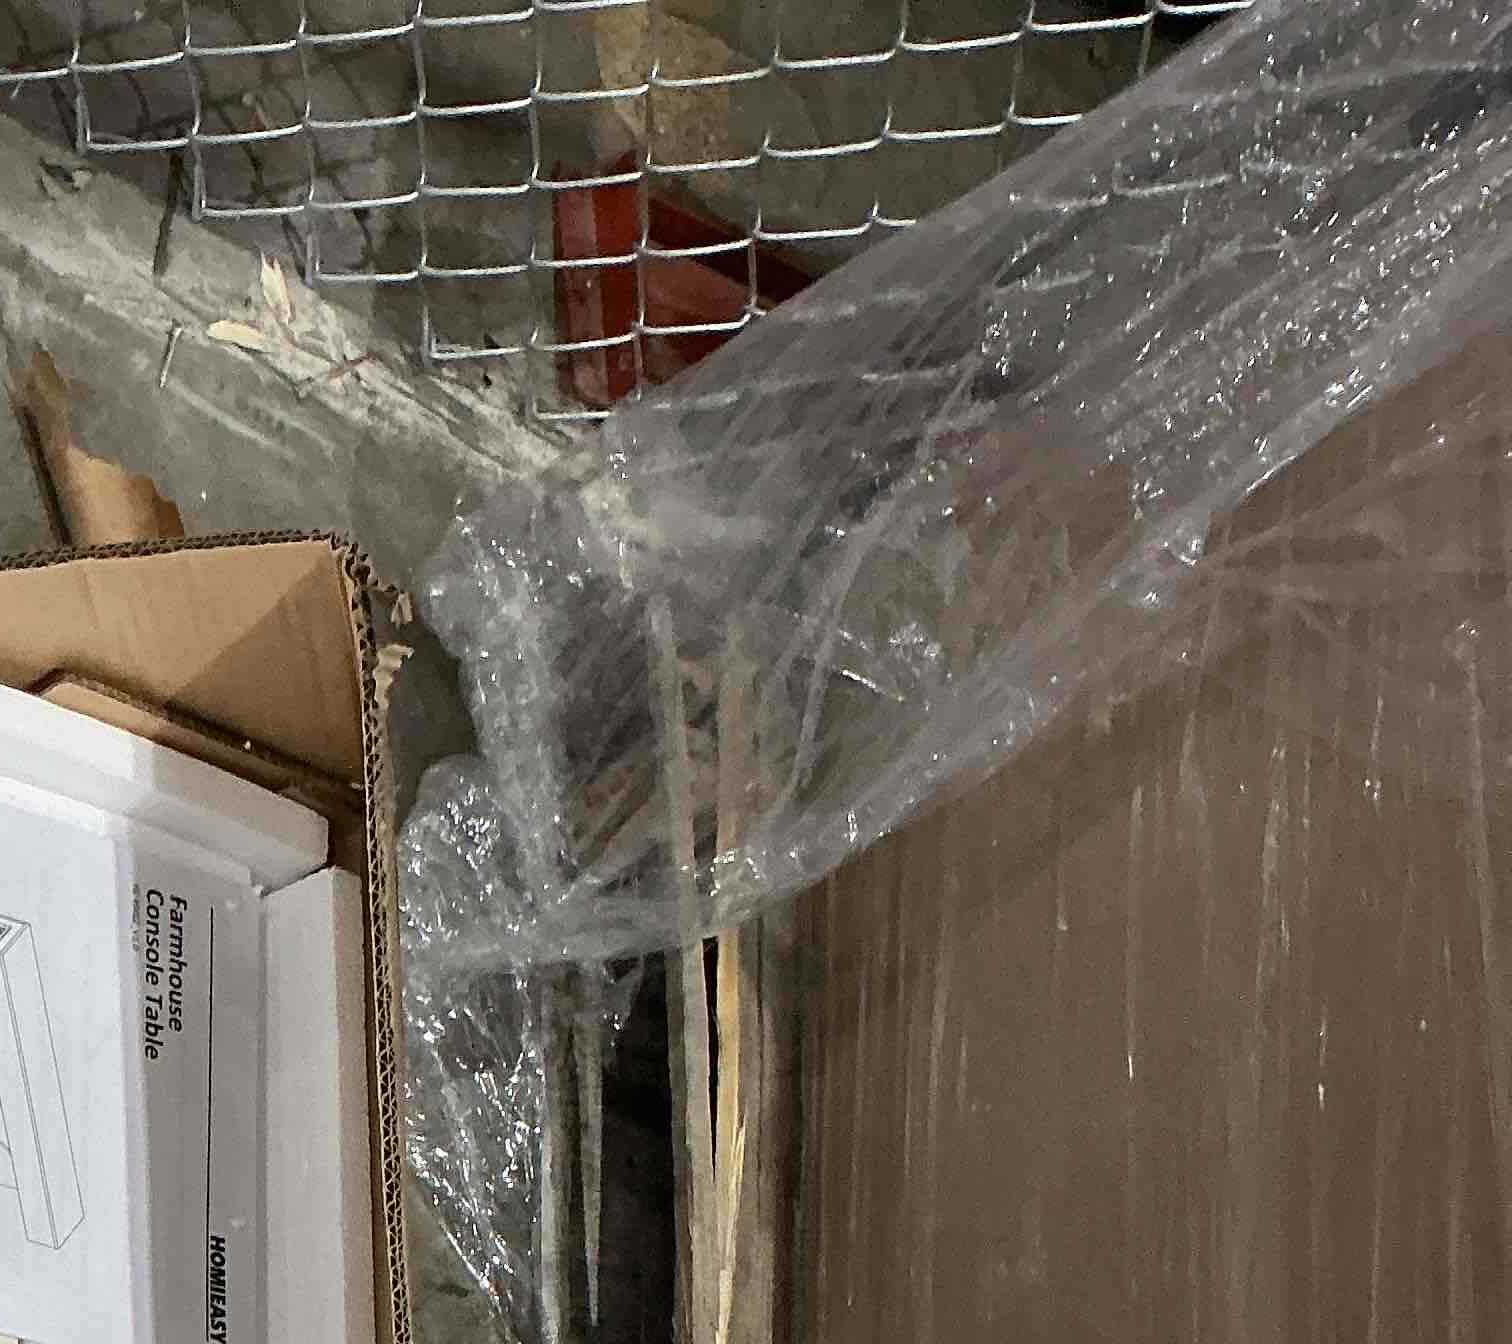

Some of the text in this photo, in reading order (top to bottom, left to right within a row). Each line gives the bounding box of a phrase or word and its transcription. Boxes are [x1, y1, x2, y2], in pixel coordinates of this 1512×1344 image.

[143, 888, 163, 1060] Console Table
[167, 894, 187, 1032] Farmhouse
